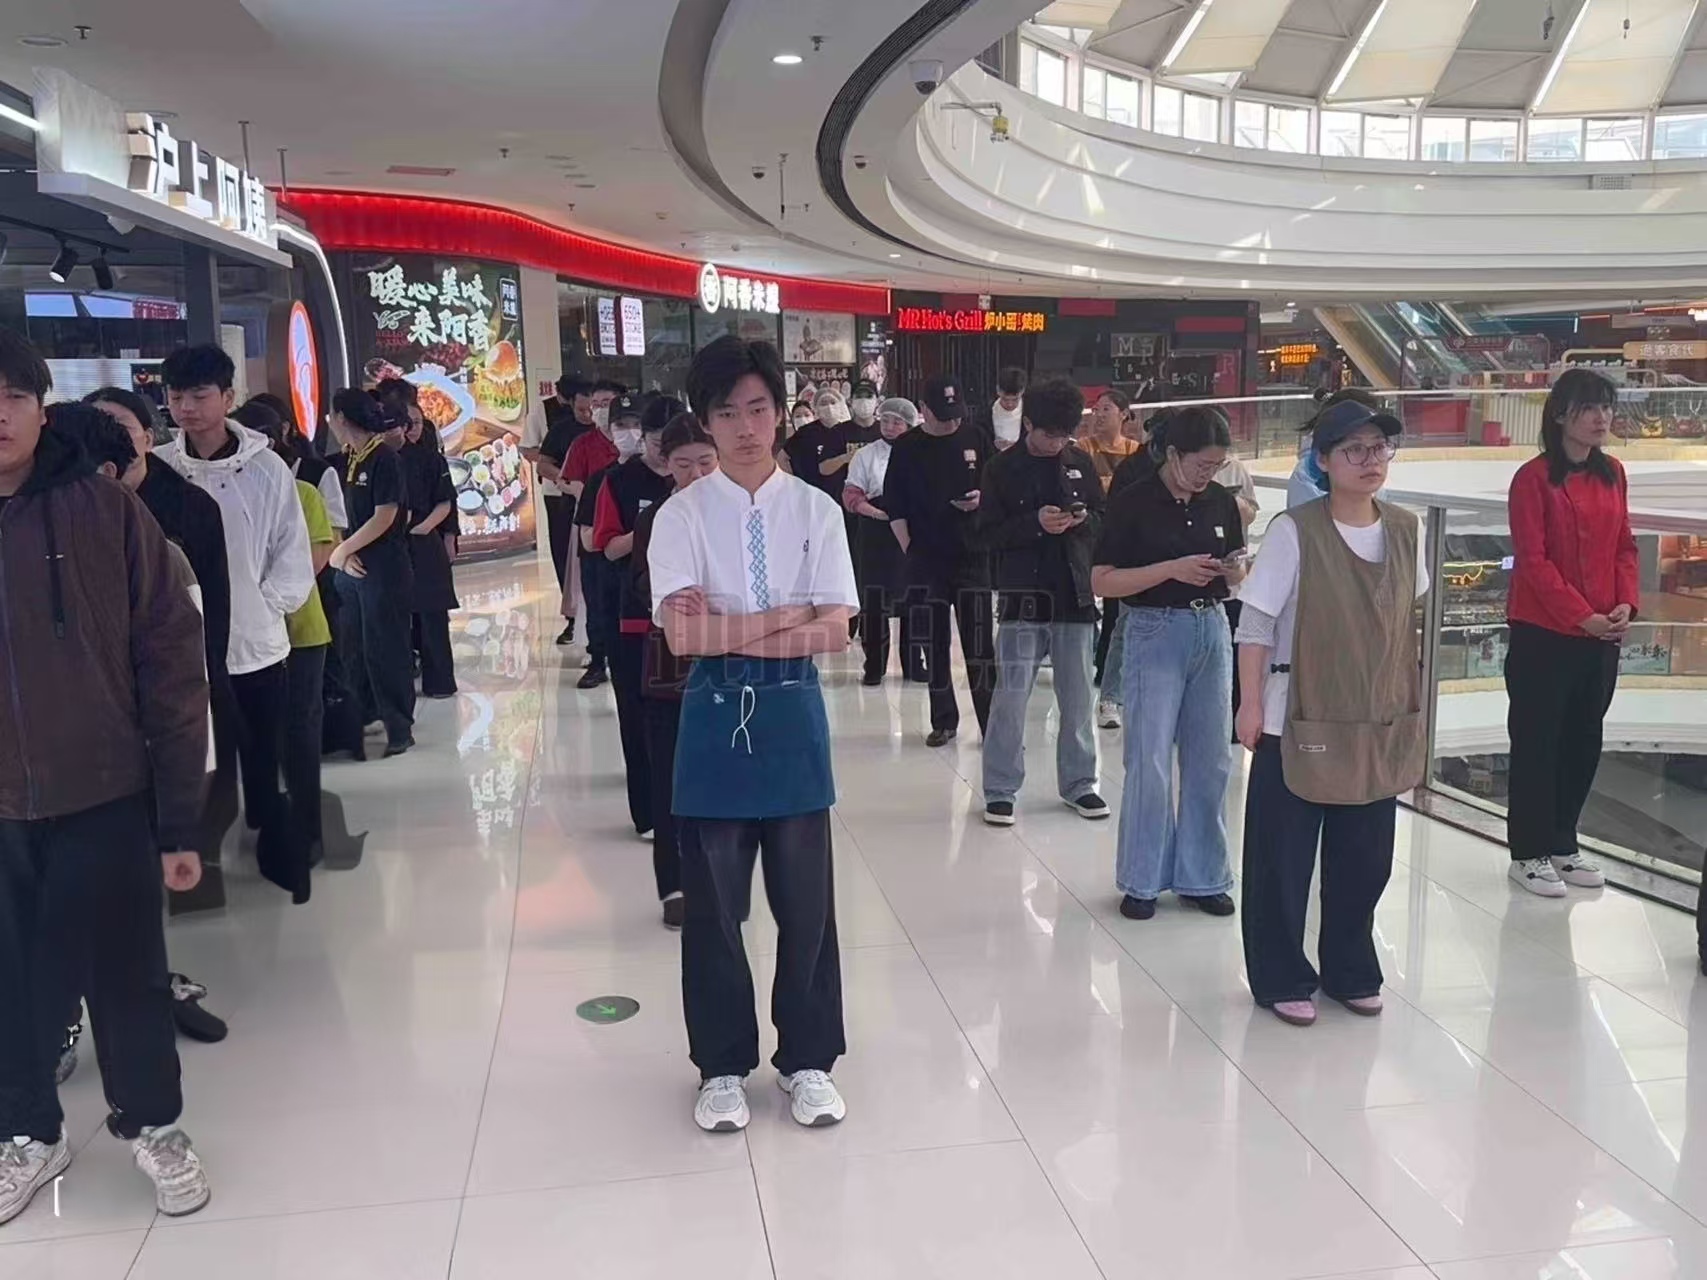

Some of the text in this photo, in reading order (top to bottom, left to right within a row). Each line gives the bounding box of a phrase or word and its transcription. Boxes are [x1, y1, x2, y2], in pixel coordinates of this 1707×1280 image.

[368, 264, 493, 308] 暖心美味
[954, 309, 983, 331] Grill
